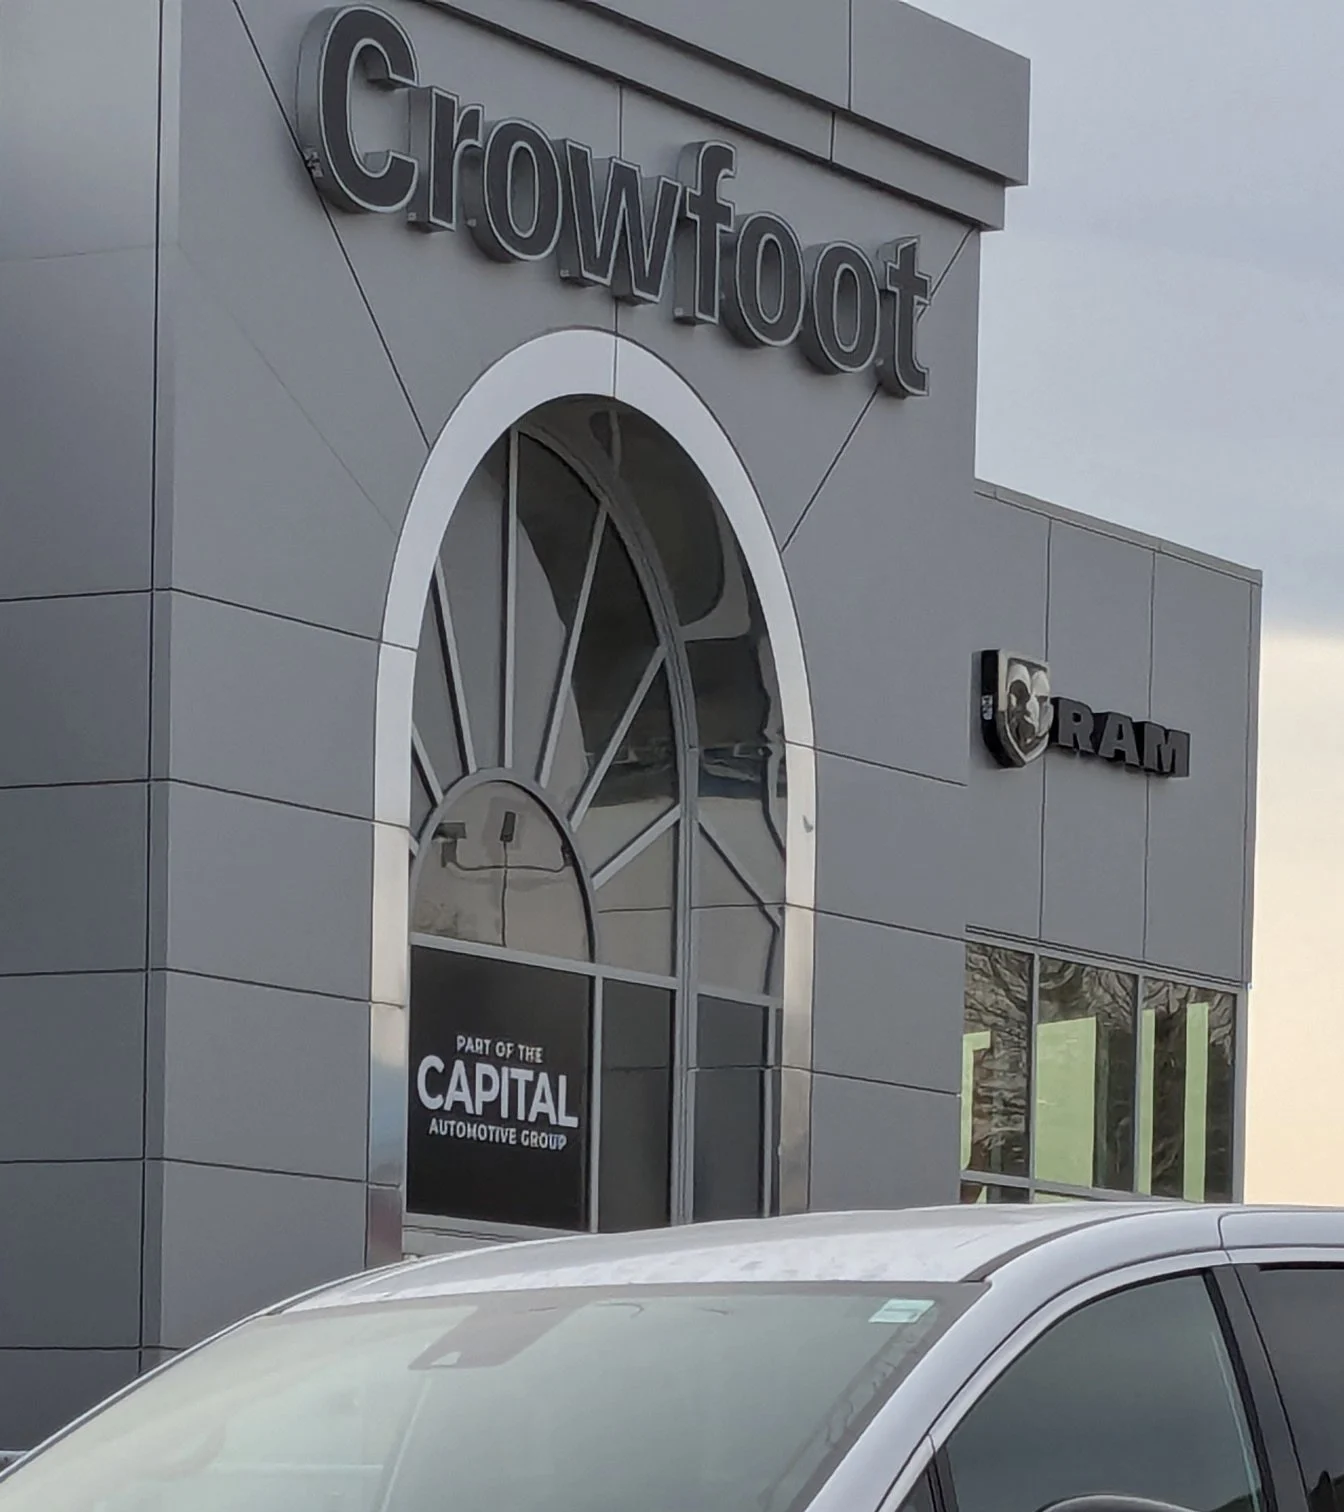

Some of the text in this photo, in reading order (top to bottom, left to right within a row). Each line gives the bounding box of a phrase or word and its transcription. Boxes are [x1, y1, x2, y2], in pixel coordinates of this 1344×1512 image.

[314, 4, 932, 398] Crowfoot
[1056, 697, 1191, 778] RAM
[456, 1035, 543, 1063] PART OF THE
[417, 1055, 578, 1128] CAPITAL
[429, 1117, 567, 1151] AUTOMOTIVE GROUP
